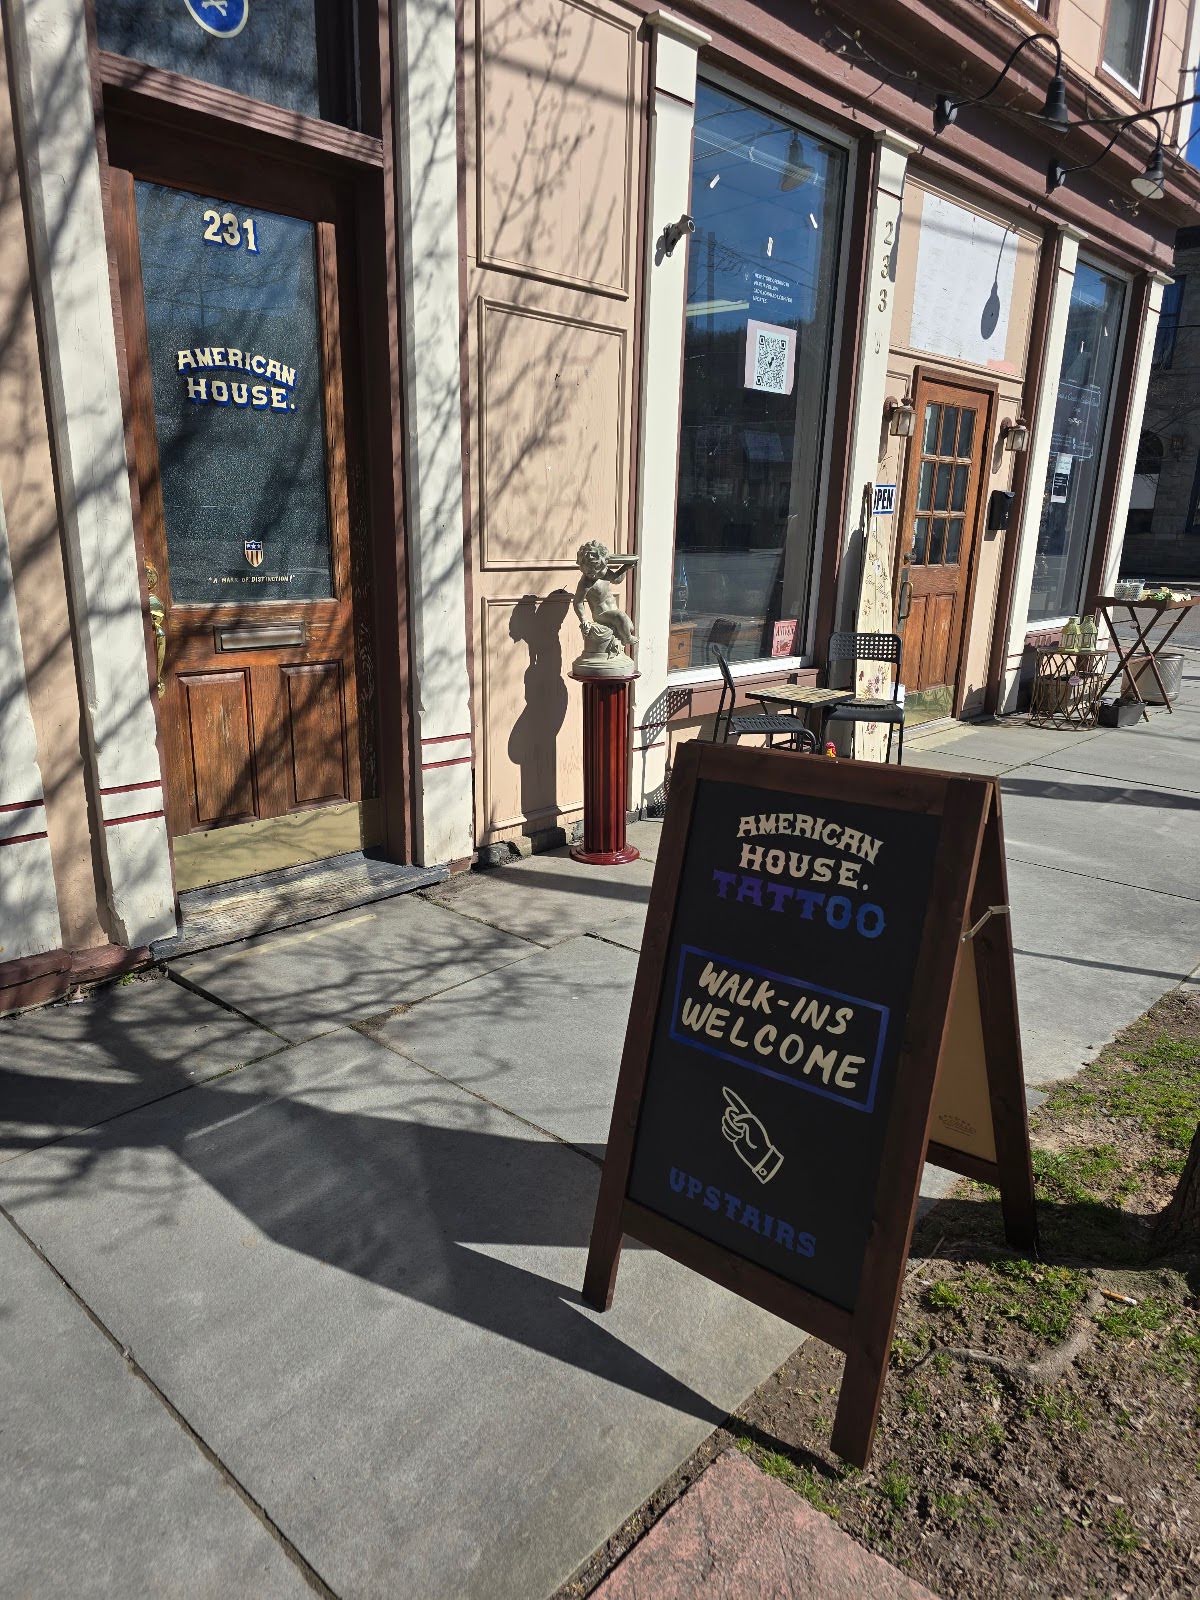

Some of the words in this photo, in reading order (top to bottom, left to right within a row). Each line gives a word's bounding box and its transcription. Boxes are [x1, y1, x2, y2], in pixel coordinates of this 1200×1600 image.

[203, 209, 259, 254] 231
[177, 347, 297, 388] AMERICAN
[186, 377, 297, 413] HOUSE.
[736, 813, 884, 865] AMERICAN
[739, 843, 869, 891] HOUSE.
[713, 869, 887, 939] TATTOO
[699, 961, 854, 1035] WALK-INS
[681, 998, 866, 1089] WELCOME
[669, 1166, 817, 1258] UPSTAIRS
